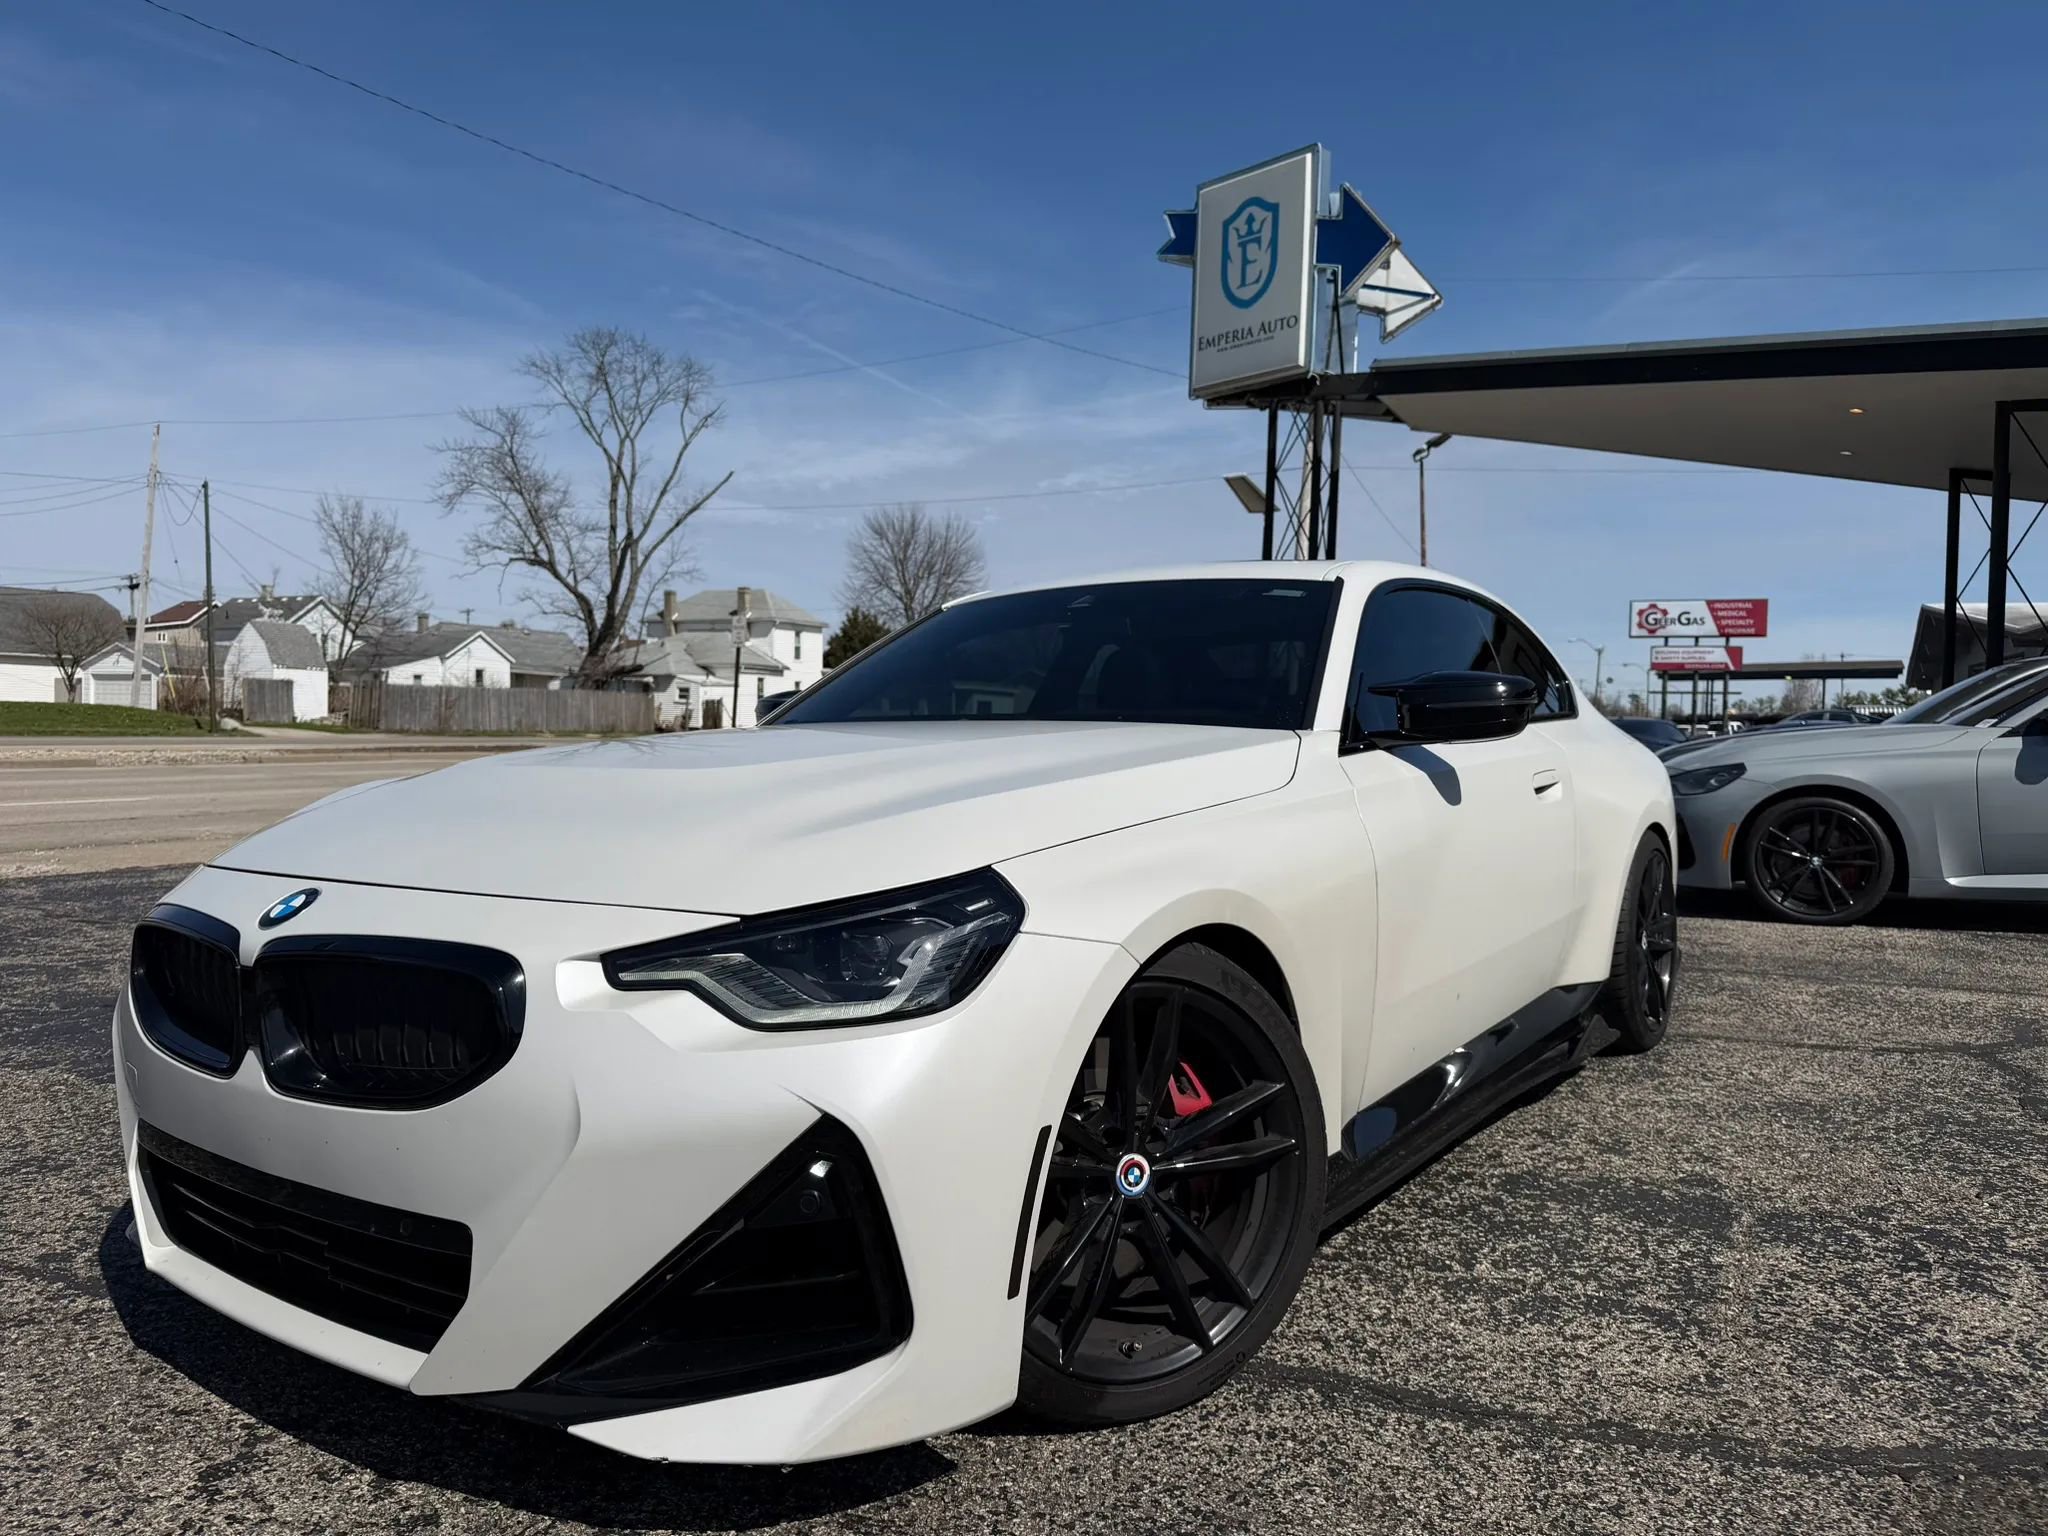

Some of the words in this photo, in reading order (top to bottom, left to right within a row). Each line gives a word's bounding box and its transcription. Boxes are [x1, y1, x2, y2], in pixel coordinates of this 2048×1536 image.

[1198, 326, 1253, 352] EMPERIA
[1257, 315, 1298, 337] AUTO
[1721, 618, 1754, 626] SPECIALTY
